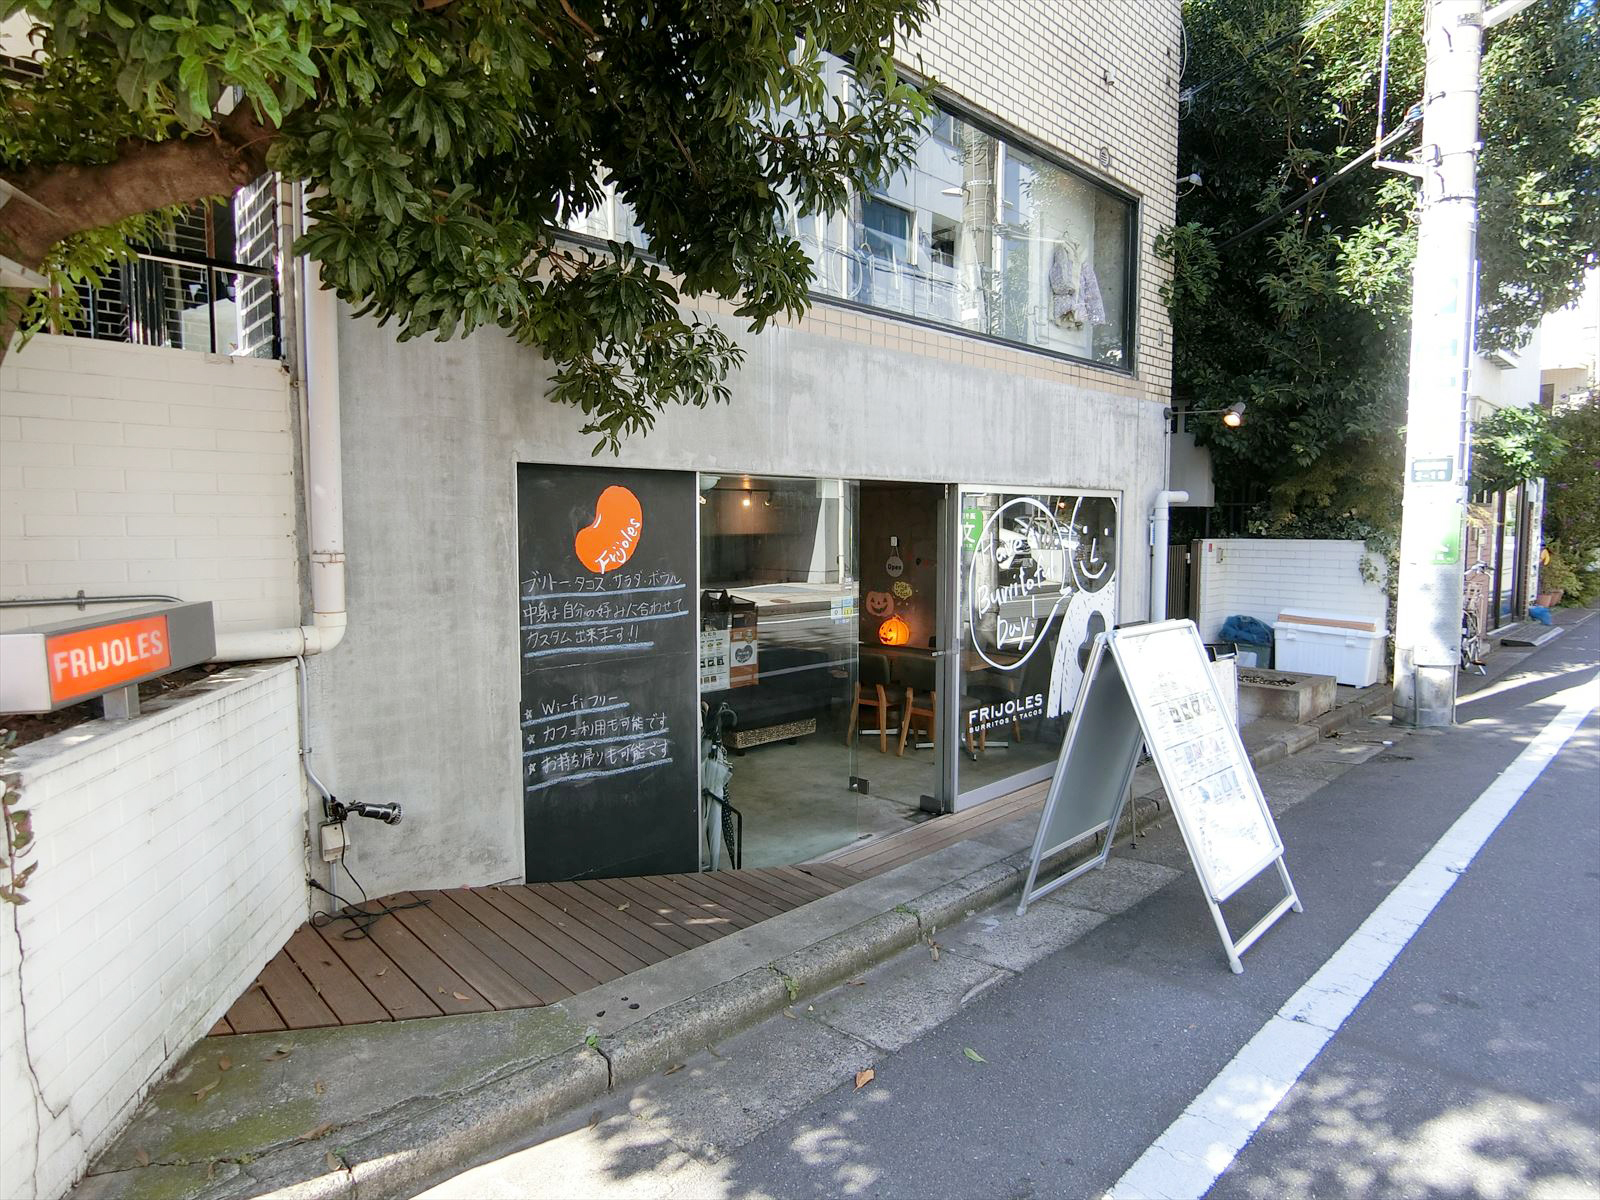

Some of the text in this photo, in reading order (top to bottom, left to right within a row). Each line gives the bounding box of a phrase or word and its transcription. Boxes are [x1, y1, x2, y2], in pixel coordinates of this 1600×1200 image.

[594, 517, 641, 575] Frijoles
[980, 531, 1023, 566] Have
[53, 629, 164, 684] FRIJOLES
[969, 693, 1043, 724] FRIJOLES
[969, 717, 1010, 734] BURRITOS
[1019, 709, 1043, 721] TACOS
